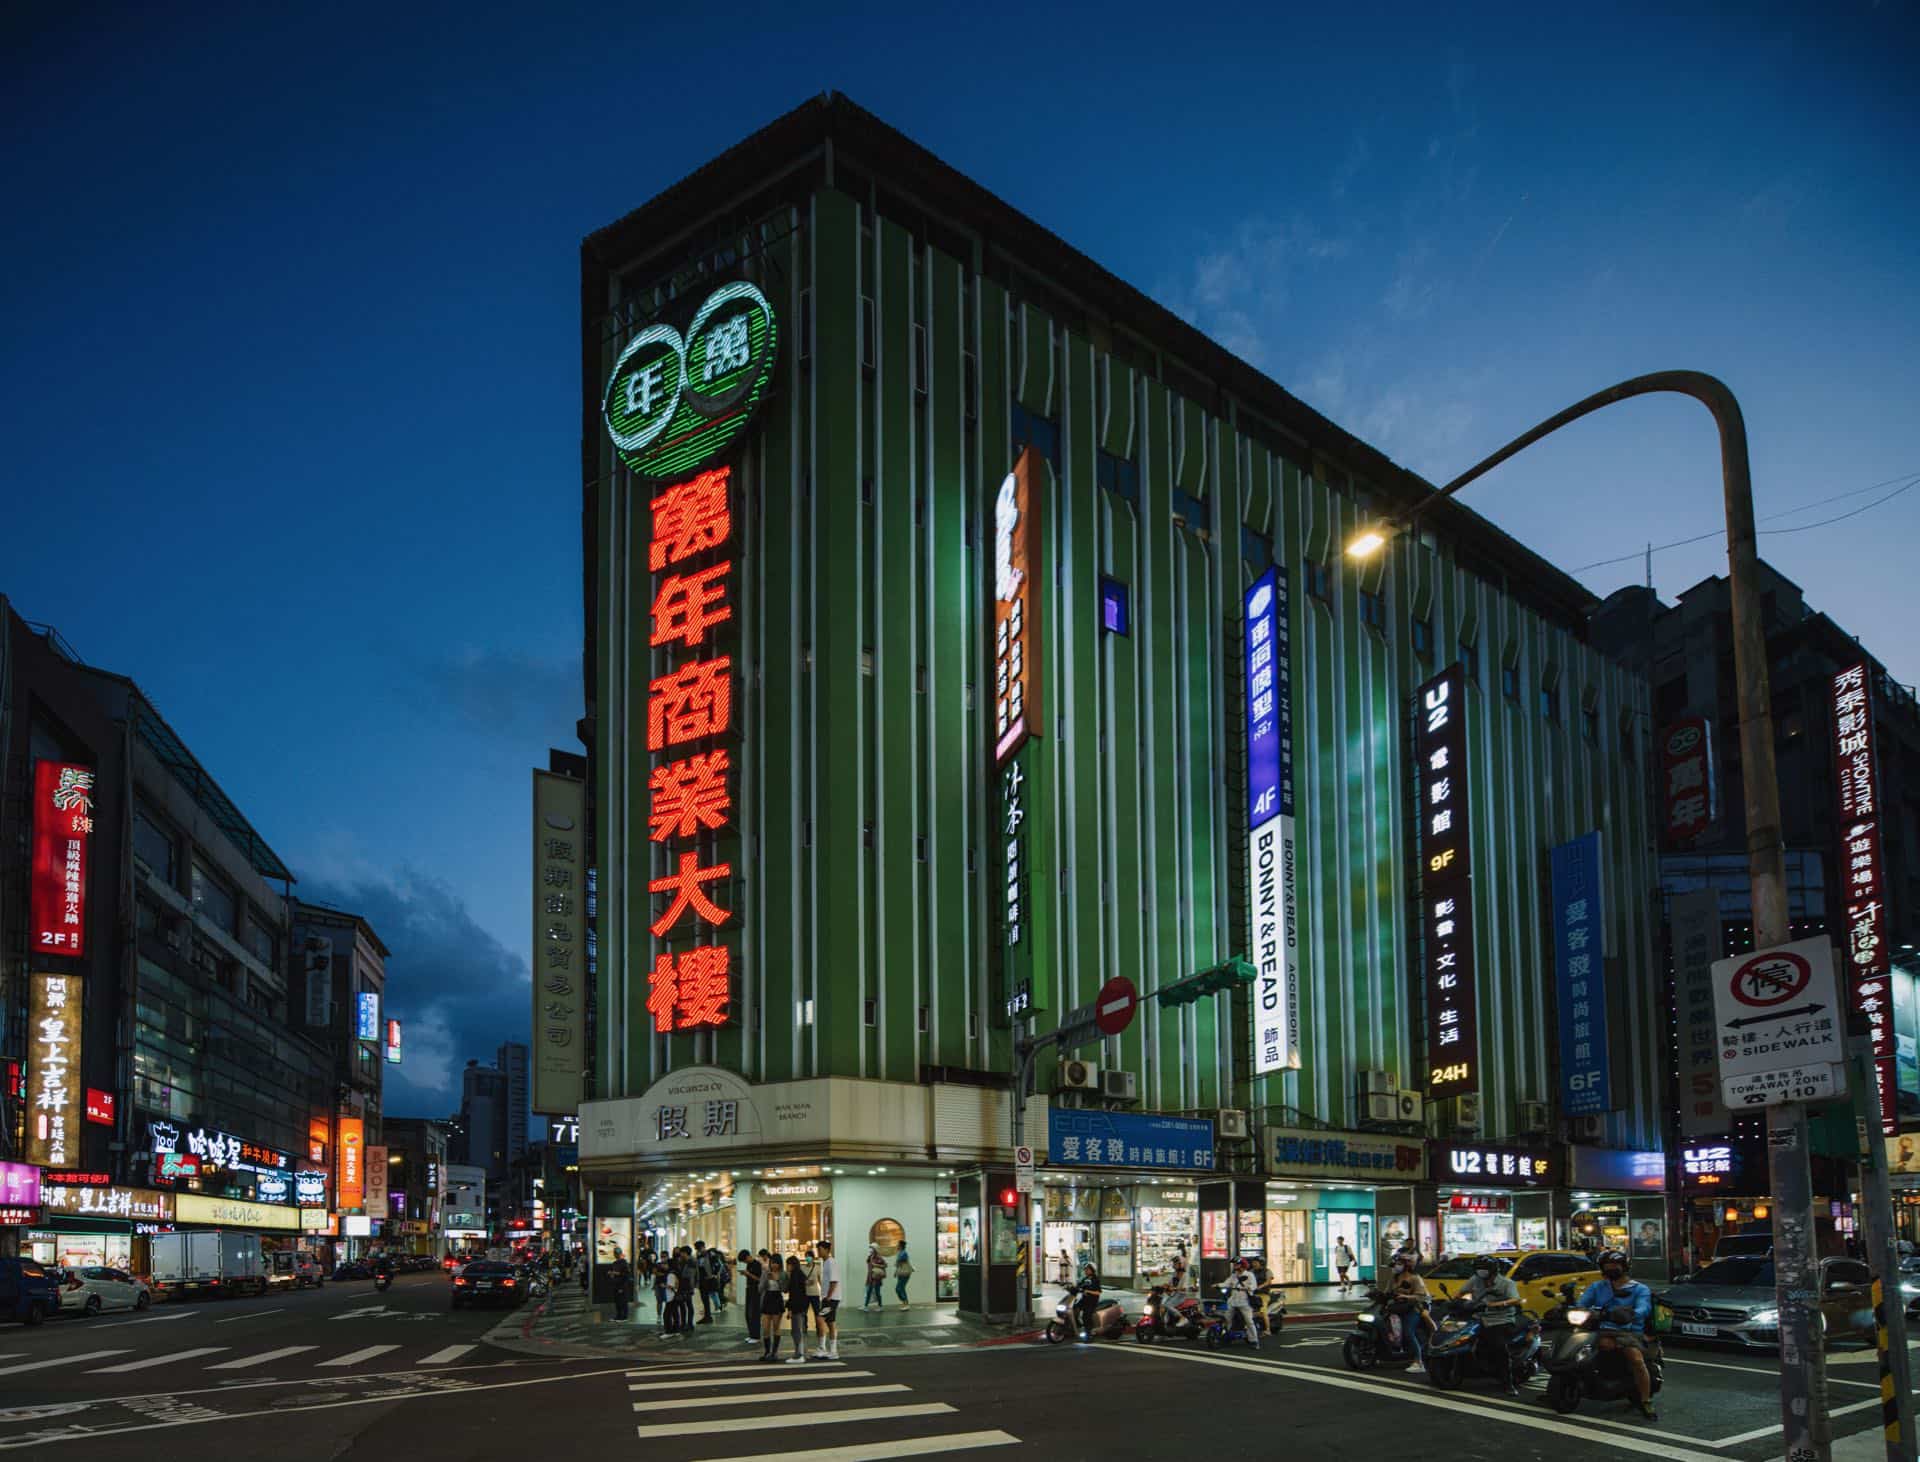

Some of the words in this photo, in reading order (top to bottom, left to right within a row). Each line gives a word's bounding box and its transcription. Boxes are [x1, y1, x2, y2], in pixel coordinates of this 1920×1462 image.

[1426, 680, 1449, 732] U2
[647, 465, 731, 1031] 萬年商業大樓
[1430, 746, 1451, 835] 電影館
[1853, 752, 1873, 816] SHOWTIME
[1254, 787, 1276, 815] 4F
[1430, 849, 1455, 871] 9F
[41, 931, 66, 945] 2F
[1743, 1033, 1833, 1056] SIDEWALK
[1432, 1063, 1468, 1084] 24H
[1569, 1071, 1601, 1090] 6F
[1731, 1079, 1791, 1094] TOW-AWAY
[1796, 1074, 1829, 1086] ZONE
[1780, 1086, 1816, 1099] 110
[653, 1100, 738, 1141] 假期
[1062, 1136, 1125, 1163] 愛客發
[1194, 1150, 1211, 1167] 6F
[1684, 1147, 1731, 1161] U2
[1451, 1151, 1480, 1173] U2
[1485, 1153, 1531, 1176] 電影館
[1535, 1159, 1548, 1174] 9F
[1685, 1159, 1731, 1175] 電影館
